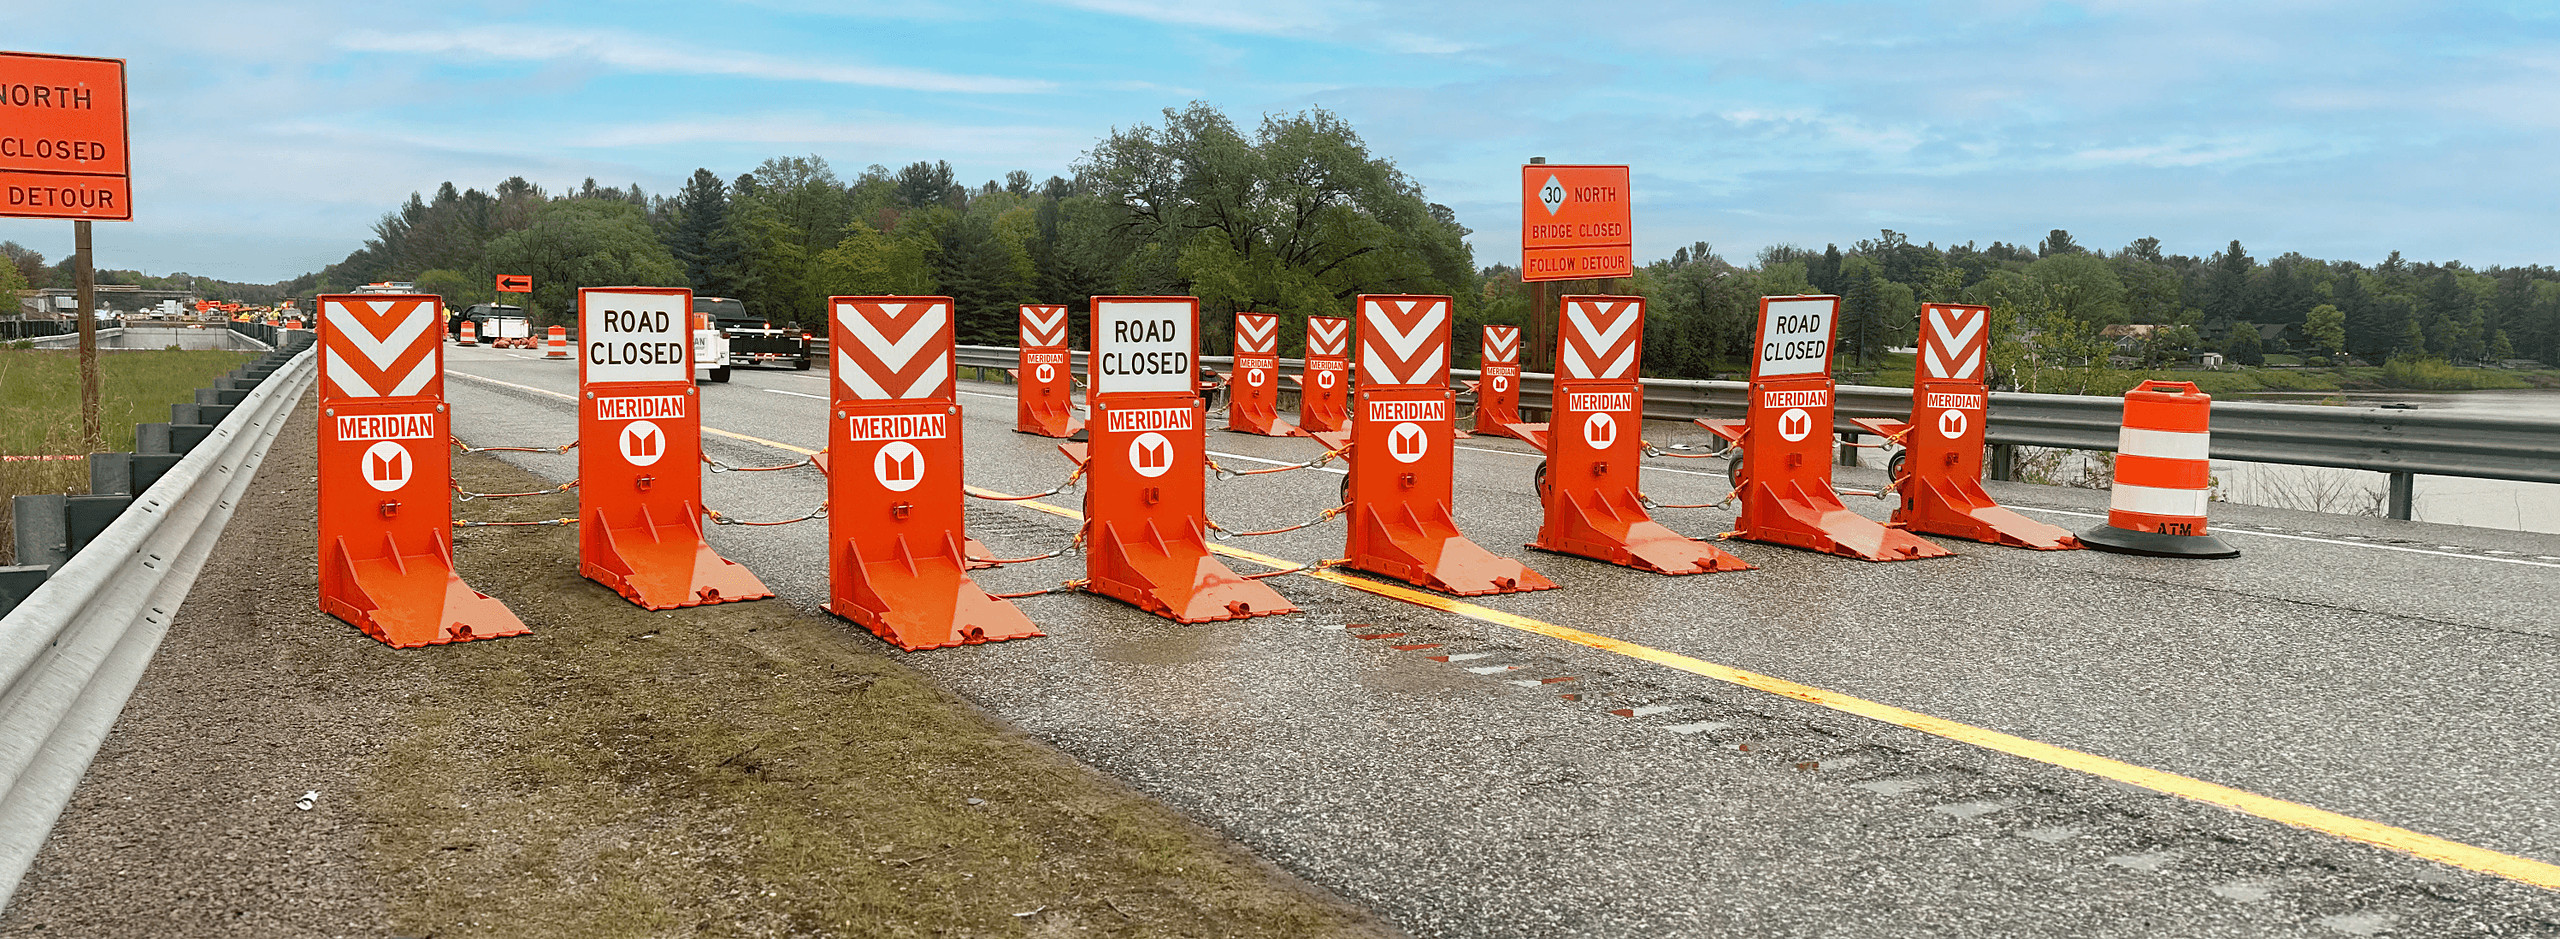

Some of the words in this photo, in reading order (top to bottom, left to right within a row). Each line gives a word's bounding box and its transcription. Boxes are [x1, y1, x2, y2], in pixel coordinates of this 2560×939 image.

[1, 137, 105, 161] CLOSED
[9, 186, 114, 209] DETOUR
[1544, 186, 1562, 204] 30
[1574, 186, 1616, 203] NORTH
[1532, 224, 1573, 239] BRIDGE
[1579, 223, 1622, 237] CLOSED
[1529, 257, 1576, 272] FOLLOW
[1582, 255, 1625, 270] DETOUR
[604, 310, 670, 333] ROAD
[1115, 320, 1176, 343] ROAD
[1776, 314, 1821, 335] ROAD
[590, 342, 683, 365] CLOSED
[1028, 354, 1063, 363] MERIDIAN
[1764, 340, 1826, 362] CLOSED
[1102, 352, 1188, 375] CLOSED
[1240, 359, 1273, 368] MERIDIAN
[1311, 361, 1343, 370] MERIDIAN
[599, 397, 684, 419] MERIDIAN
[1571, 394, 1631, 410] MERIDIAN
[1766, 391, 1826, 407] MERIDIAN
[1928, 394, 1980, 408] MERIDIAN
[1110, 409, 1191, 430] MERIDIAN
[1371, 402, 1444, 420] MERIDIAN
[340, 415, 433, 439] MERIDIAN
[852, 415, 945, 439] MERIDIAN
